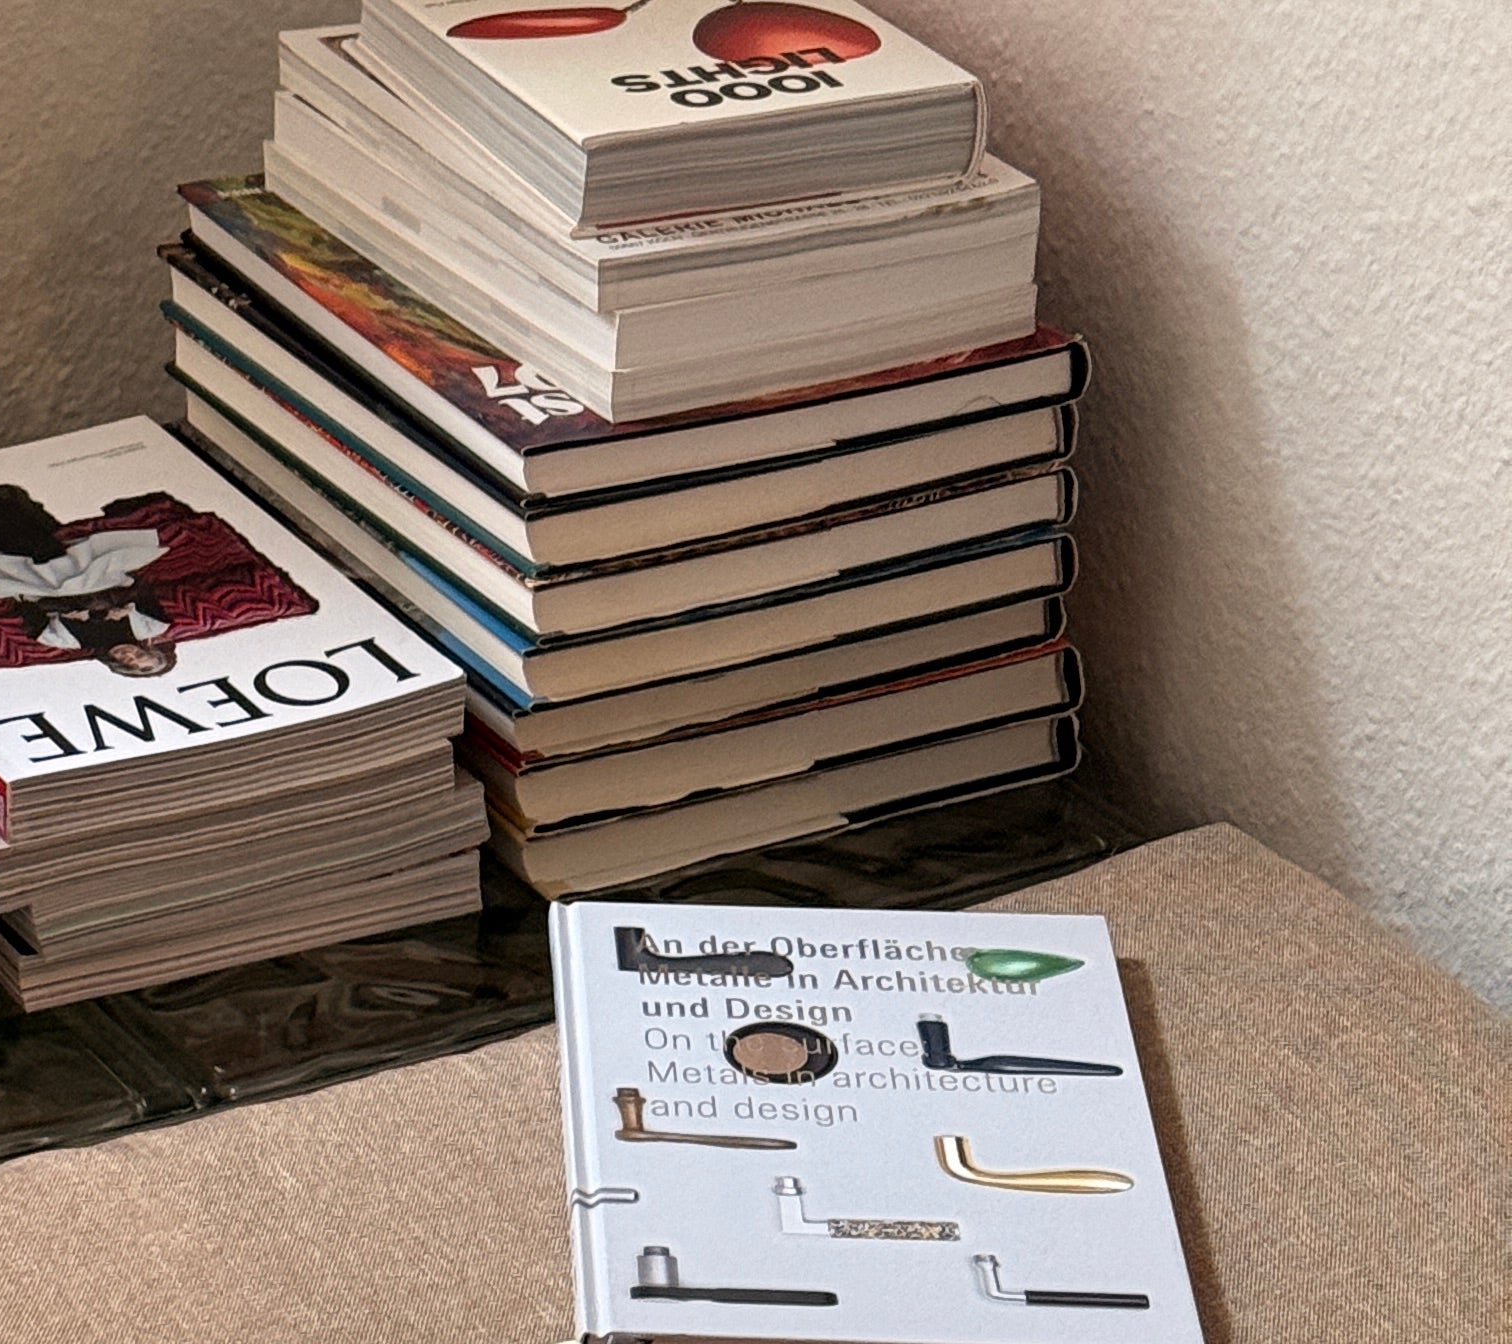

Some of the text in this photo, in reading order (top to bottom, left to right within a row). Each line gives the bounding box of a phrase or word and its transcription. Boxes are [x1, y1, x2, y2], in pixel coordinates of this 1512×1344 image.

[610, 46, 847, 92] LIGHTS
[670, 70, 844, 107] 1000
[638, 933, 683, 955] An
[699, 935, 757, 956] der
[639, 963, 1040, 995] Metalle in Architektur
[642, 997, 853, 1026] und Design
[644, 1028, 692, 1050] On
[707, 1030, 764, 1052] the
[647, 1060, 1057, 1094] Metals in architecture
[651, 1095, 858, 1127] and design
